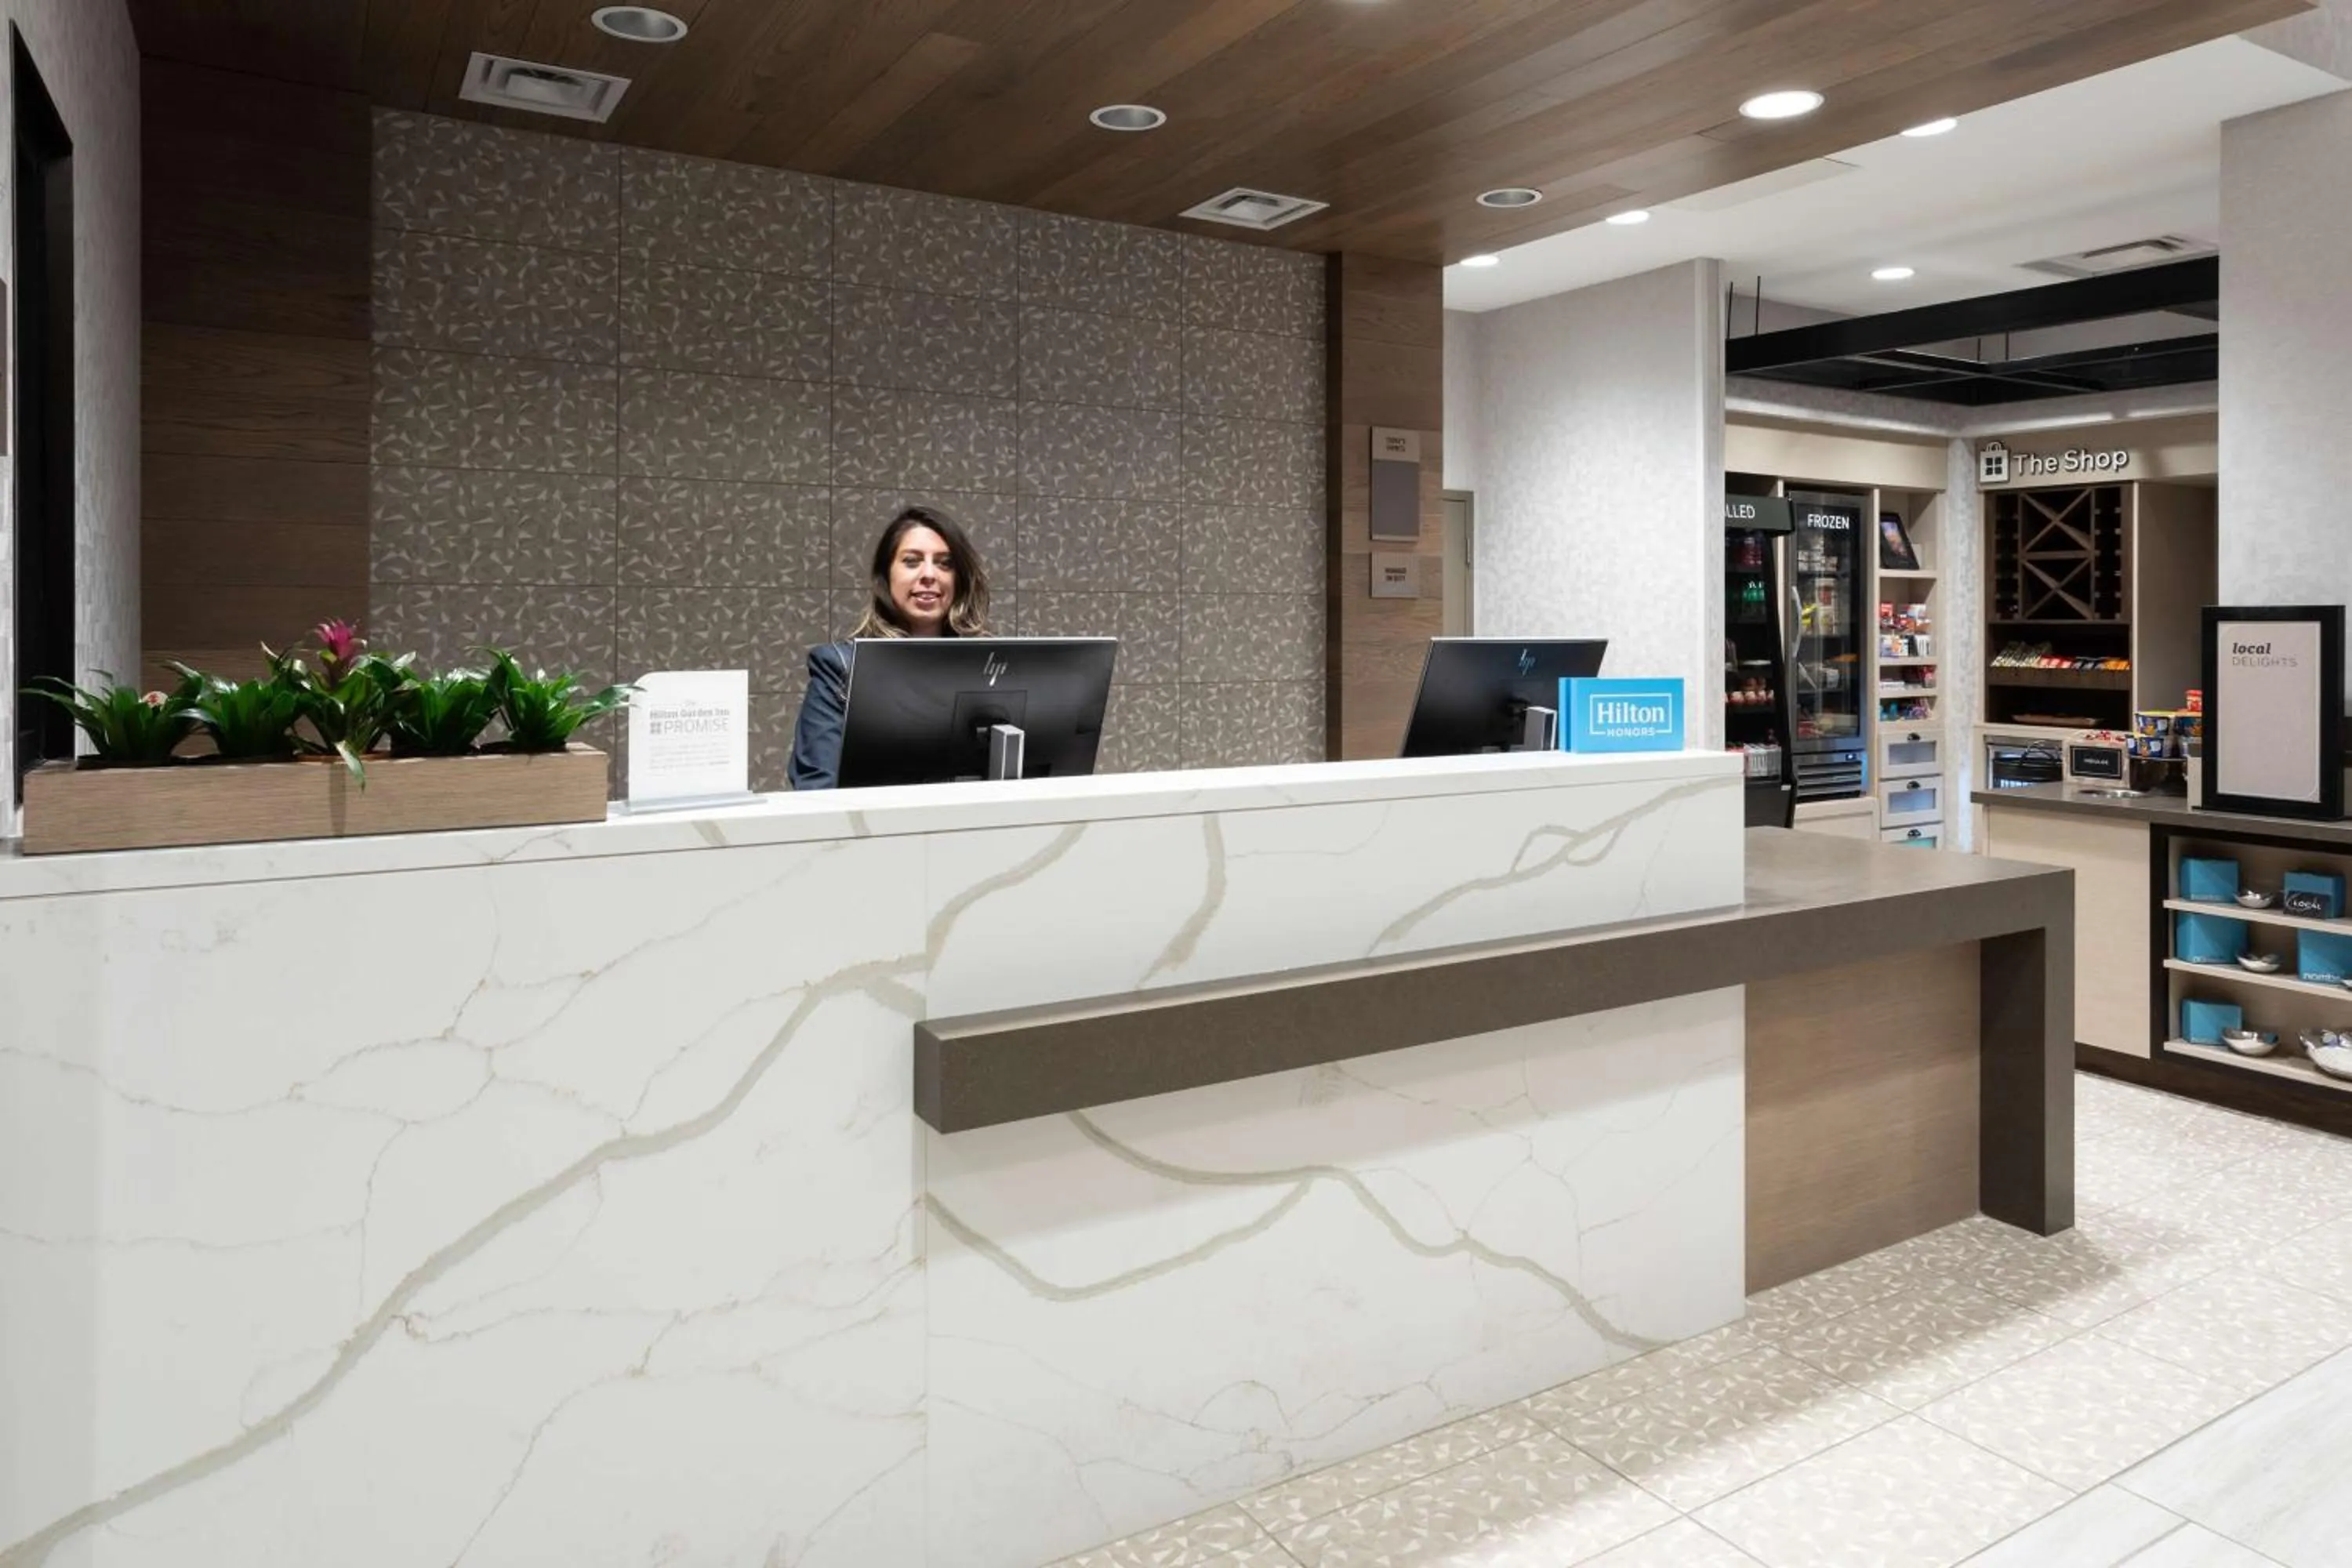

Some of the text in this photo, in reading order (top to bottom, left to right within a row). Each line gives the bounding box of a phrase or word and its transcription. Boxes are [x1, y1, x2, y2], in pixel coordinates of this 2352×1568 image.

[2013, 449, 2129, 475] The Shop
[1725, 503, 1755, 519] LLED
[1807, 514, 1850, 530] FROZEN
[2232, 642, 2271, 655] local
[2232, 655, 2299, 667] DELIGHTS
[1596, 702, 1664, 724] Hilton
[664, 717, 729, 735] PROMISE
[1606, 727, 1656, 737] HONORS
